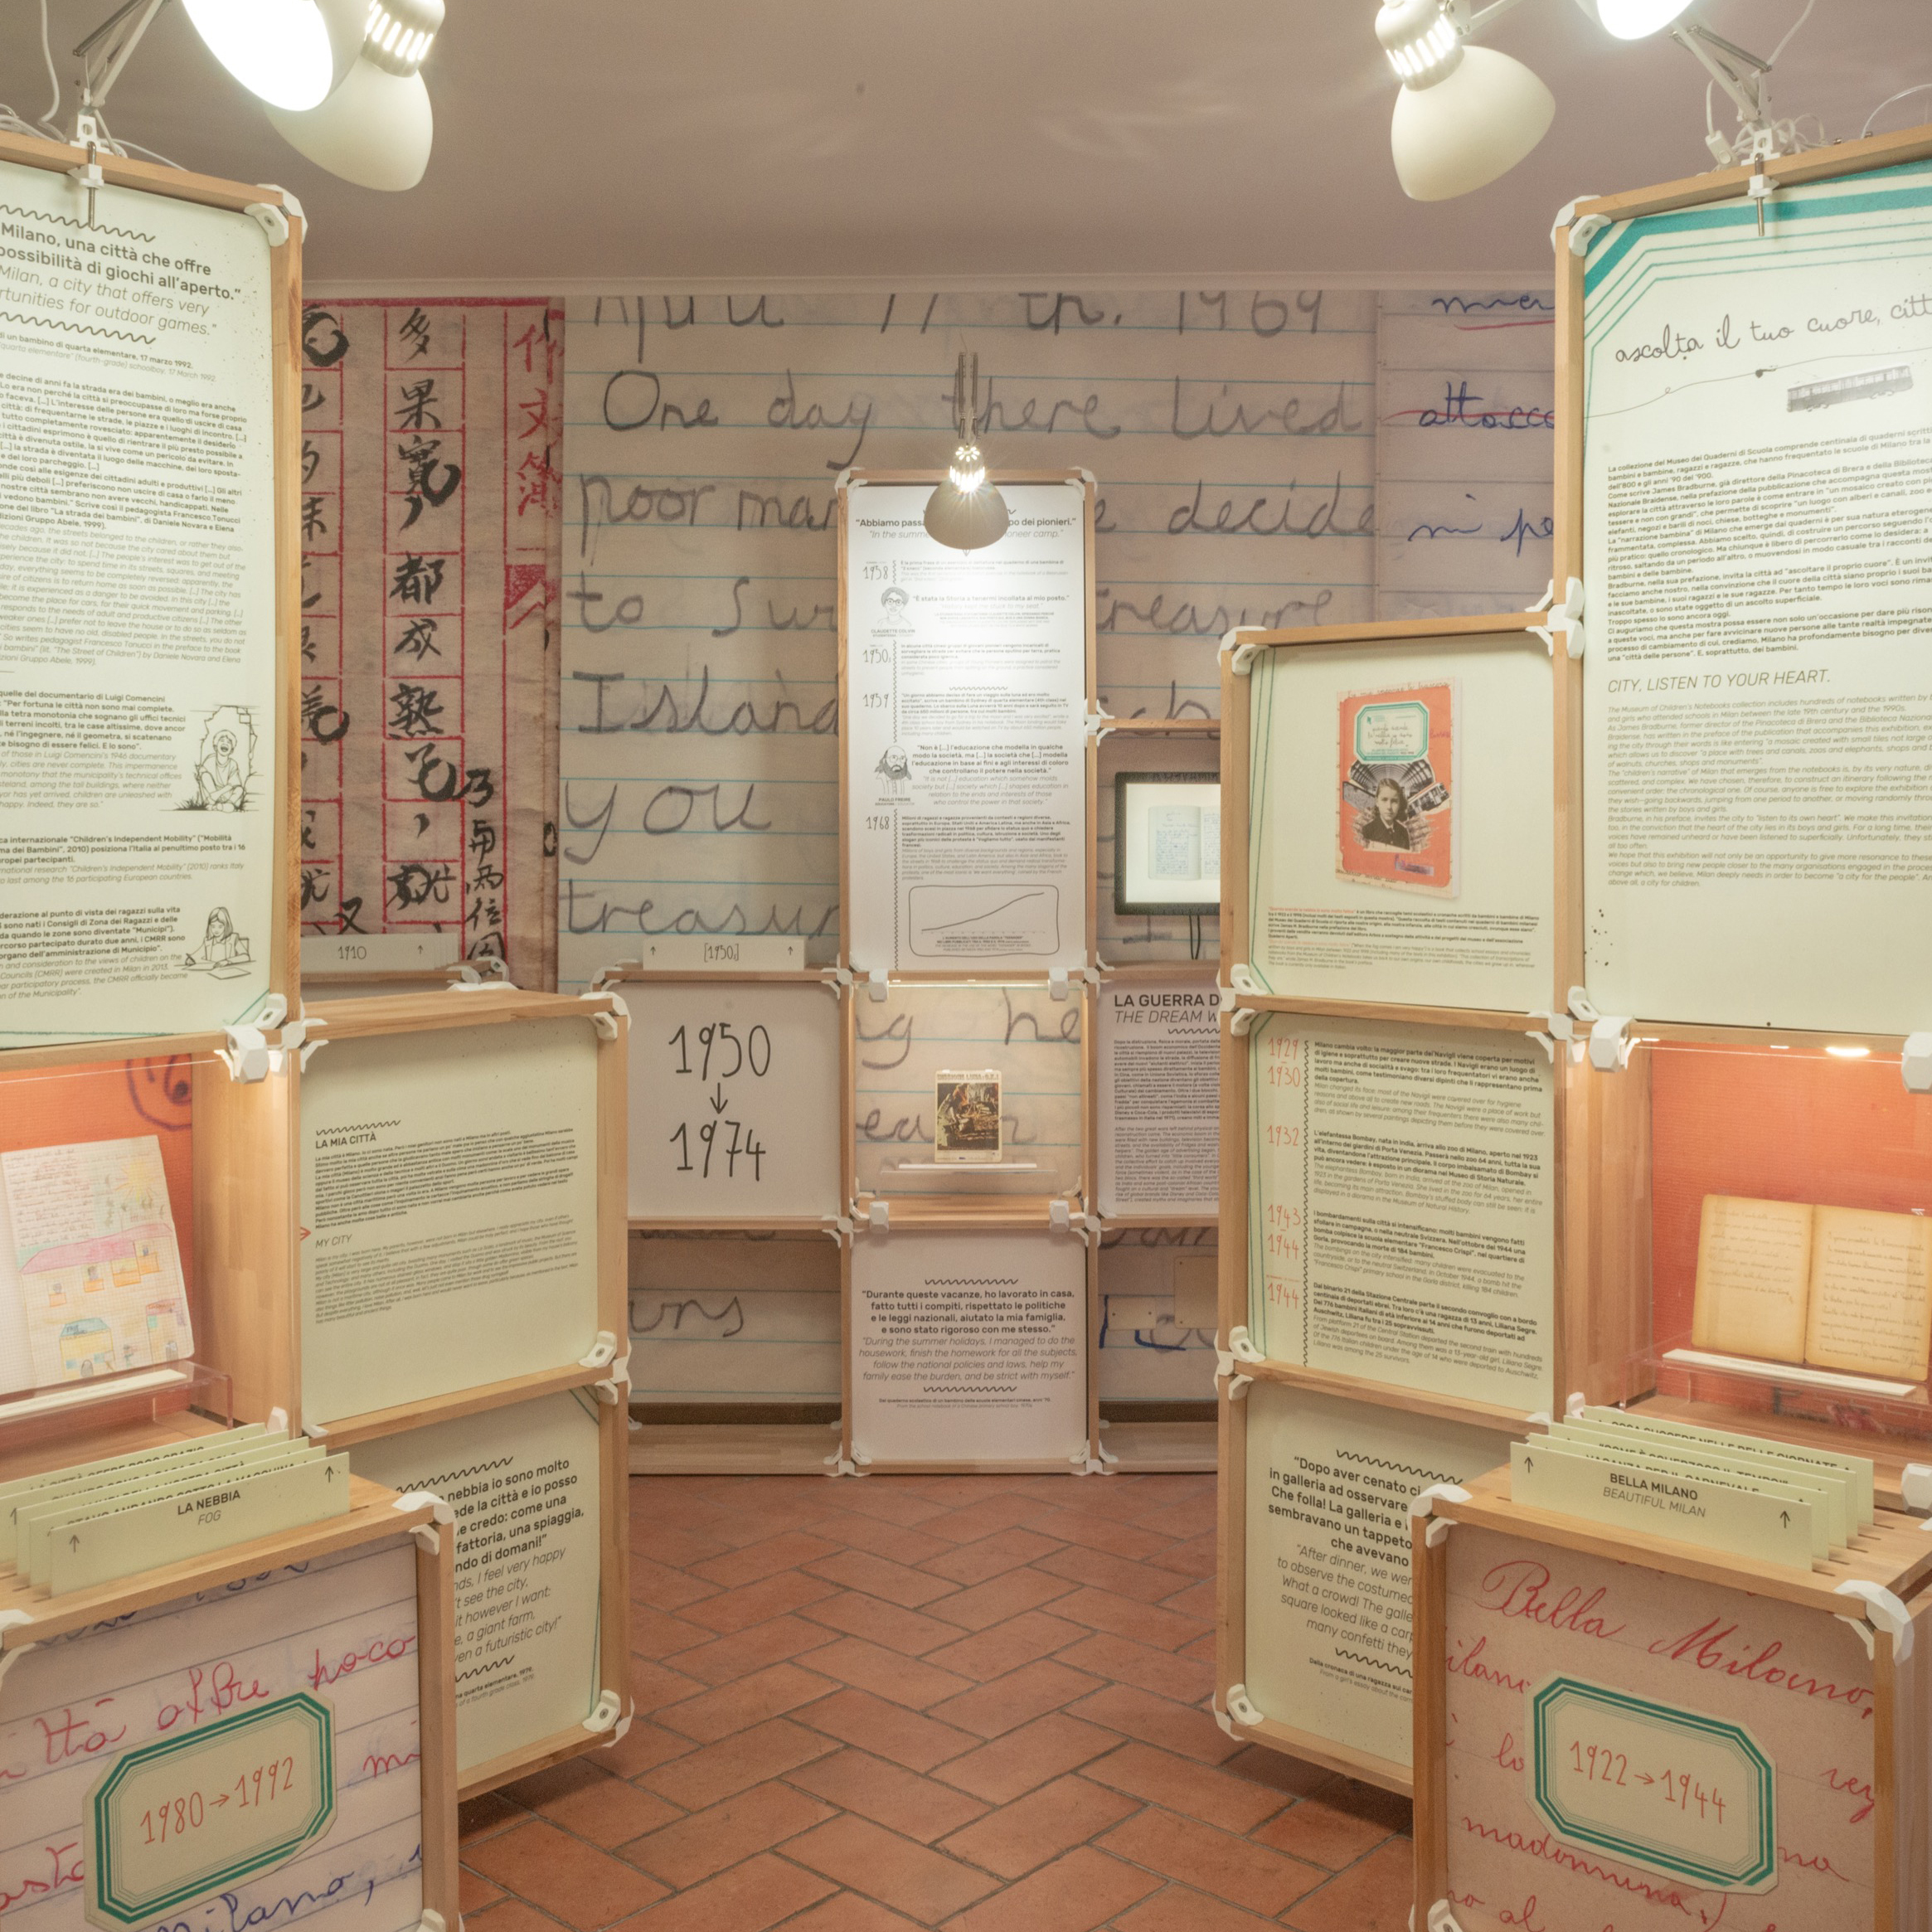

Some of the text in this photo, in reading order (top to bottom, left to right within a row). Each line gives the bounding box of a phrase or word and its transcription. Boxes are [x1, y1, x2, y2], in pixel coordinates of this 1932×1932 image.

[66, 237, 95, 253] una
[100, 243, 137, 261] città
[142, 251, 170, 267] che
[86, 260, 100, 274] di
[105, 265, 153, 284] giochi
[48, 276, 58, 288] a
[63, 277, 92, 296] city
[96, 282, 128, 300] that
[131, 290, 173, 308] offers
[178, 300, 209, 317] very
[69, 298, 91, 313] for
[95, 305, 154, 324] outdoor
[1615, 294, 1932, 362] ascolta il tuo cuore, citt
[604, 370, 718, 431] One
[768, 368, 871, 471] day
[580, 473, 716, 566] poor
[862, 565, 888, 580] 1958
[1633, 616, 1658, 624] spesso
[1712, 610, 1730, 619] oggi.
[1608, 668, 1829, 692] CITY, LISTEN TO YOUR HEART.
[862, 693, 889, 708] 1959
[564, 780, 770, 864] you
[866, 816, 889, 829] 1968
[338, 946, 366, 960] 1910
[1114, 993, 1204, 1007] LA GUERRA
[1114, 1009, 1202, 1023] THE DREAM
[668, 1023, 771, 1080] 1950
[1268, 1036, 1299, 1061] 1929
[1269, 1066, 1300, 1087] 1930
[315, 1131, 376, 1148] LA MIA CITTÀ
[1267, 1124, 1299, 1146] 1932
[670, 1121, 766, 1182] 1974
[1268, 1204, 1300, 1228] 1943
[315, 1233, 352, 1248] MY CITY
[1268, 1234, 1299, 1259] 1944
[871, 1301, 895, 1310] fatto
[896, 1302, 917, 1310] tutti
[925, 1302, 963, 1311] compiti,
[965, 1302, 1012, 1311] rispettato
[1014, 1301, 1022, 1309] le
[1025, 1301, 1066, 1311] politiche
[906, 1290, 938, 1299] queste
[998, 1289, 1037, 1298] lavorato
[1268, 1282, 1299, 1308] 1944
[889, 1313, 911, 1323] leggi
[914, 1313, 957, 1322] nazionali,
[1006, 1313, 1022, 1321] mia
[1025, 1313, 1065, 1323] famiglia,
[914, 1325, 938, 1333] stato
[940, 1325, 979, 1335] rigoroso
[447, 1459, 569, 1503] nebbia io sono molto
[477, 1474, 577, 1512] la città e io posso
[1269, 1467, 1408, 1512] in galleria ad osservare
[1332, 1468, 1360, 1482] aver
[1362, 1475, 1406, 1494] cenato
[1410, 1485, 1420, 1496] ci
[1609, 1473, 1648, 1490] BELLA
[1651, 1481, 1697, 1500] MILANO
[177, 1489, 240, 1515] LA NEBBIA
[469, 1495, 566, 1532] credo: come una
[1271, 1485, 1401, 1528] Che folla! La galleria e
[1602, 1486, 1706, 1517] BEAUTIFUL MILAN
[197, 1509, 221, 1525] FOG
[1268, 1503, 1413, 1549] sembravano un tappeto
[456, 1507, 584, 1554] fattoria, una spiaggia,
[481, 1551, 492, 1564] di
[1331, 1537, 1409, 1566] che avevano
[1474, 1560, 1626, 1638] Bella
[1570, 1740, 1726, 1823] 1922 1944
[139, 1756, 294, 1844] 1980 1992
